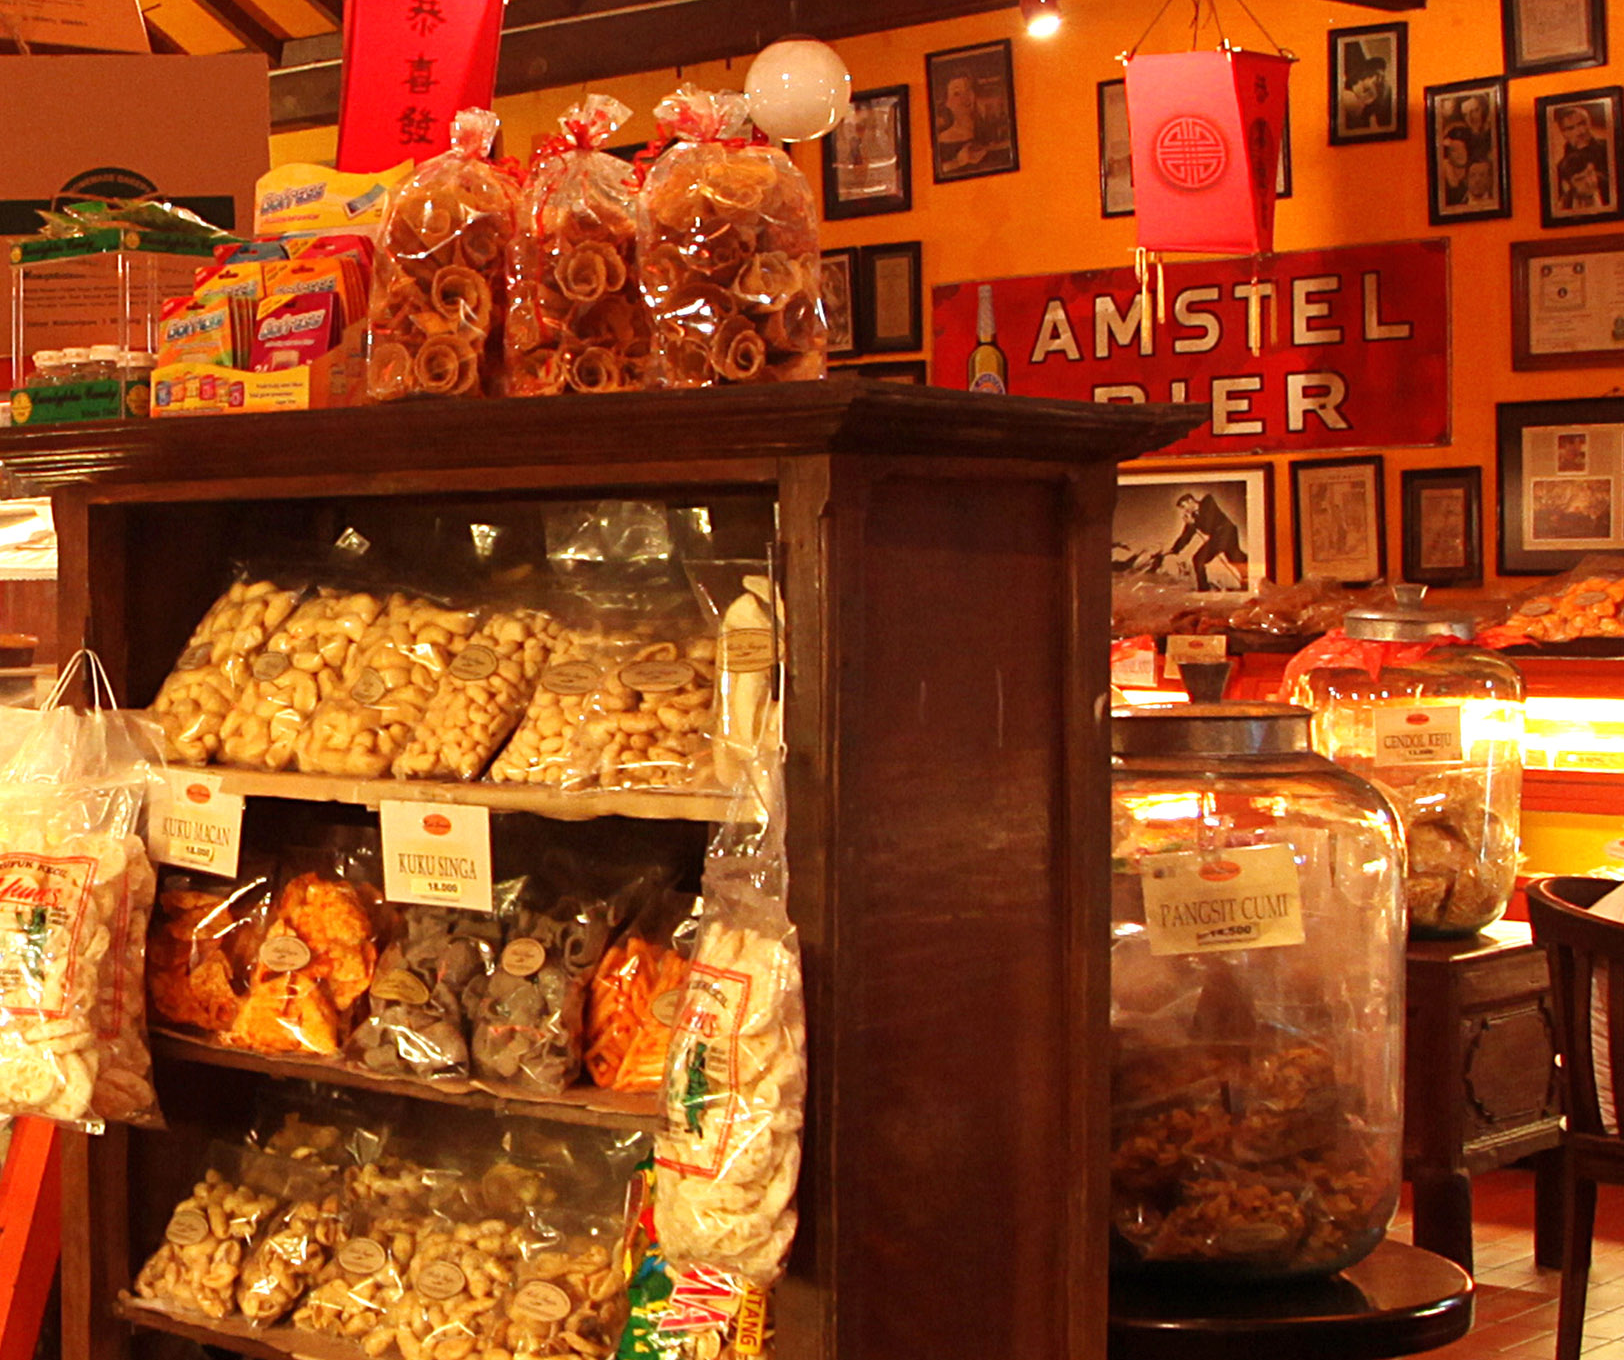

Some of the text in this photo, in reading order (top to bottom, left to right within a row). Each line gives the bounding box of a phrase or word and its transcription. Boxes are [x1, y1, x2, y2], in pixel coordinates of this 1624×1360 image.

[1029, 269, 1415, 365] AMSTEL
[163, 817, 192, 840] KUKU
[398, 853, 478, 880] KUKU SINGA
[1160, 893, 1290, 927] PANGSIT CUMI
